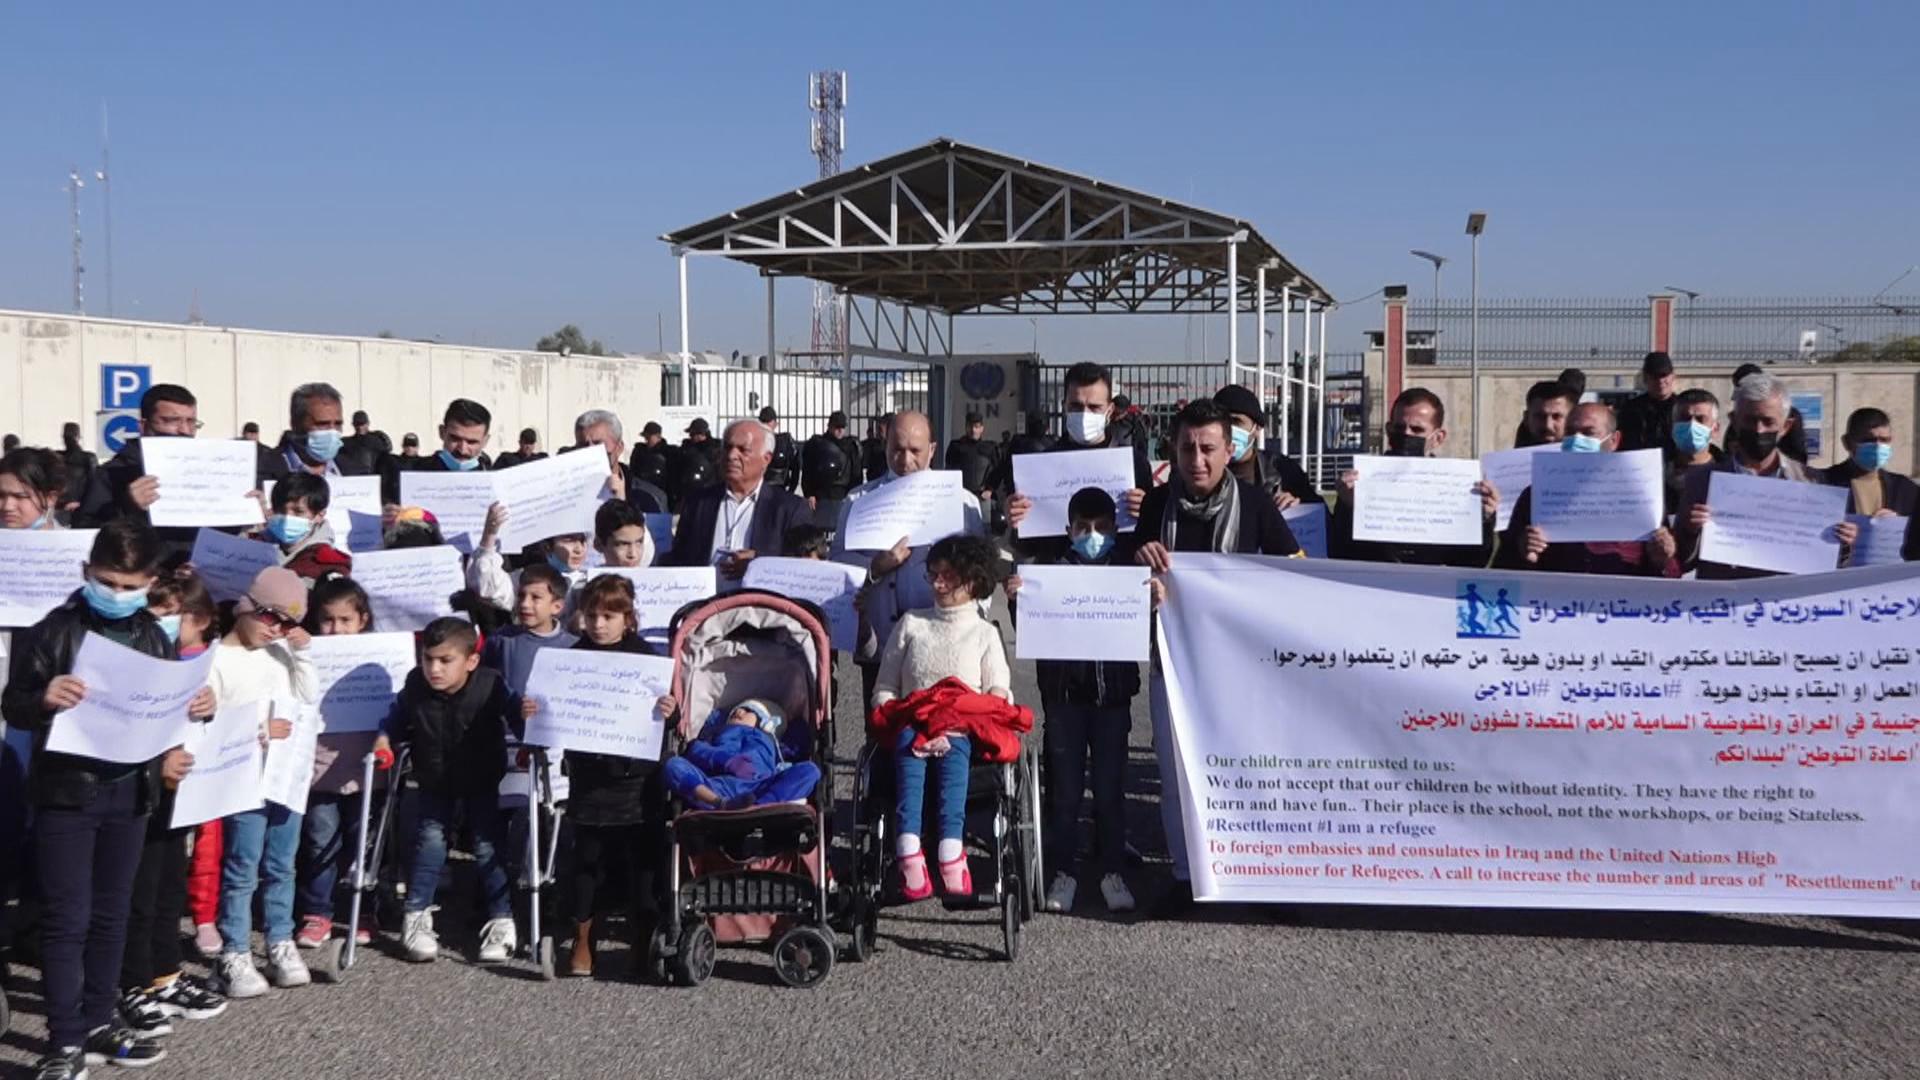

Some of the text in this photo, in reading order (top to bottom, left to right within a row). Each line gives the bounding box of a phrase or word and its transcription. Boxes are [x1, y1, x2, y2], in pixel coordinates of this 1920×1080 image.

[112, 371, 141, 407] P
[1076, 611, 1138, 620] RESETTLEMENT
[1744, 598, 1766, 627] في
[1343, 648, 1395, 669] يتعلموا
[1421, 648, 1461, 669] حقهم
[1468, 651, 1488, 669] من
[1545, 653, 1584, 672] بدون
[1611, 650, 1653, 671] القيد
[1659, 650, 1718, 675] مكتومي
[1794, 654, 1841, 673] يصبح
[1748, 684, 1789, 703] بدون
[1524, 712, 1580, 729] المتحدة
[1632, 711, 1696, 735] السامية
[1787, 714, 1839, 735] العراق
[1845, 712, 1866, 739] في
[1206, 754, 1455, 772] Our children are entrusted to us:
[1206, 775, 1815, 803] We do not accept that our children be without identity. They have the right to
[1207, 797, 1244, 810] learn
[1250, 798, 1277, 811] and
[1282, 798, 1317, 811] have
[1361, 799, 1403, 813] Their
[1409, 800, 1448, 817] place
[1453, 800, 1465, 815] is
[1470, 801, 1495, 816] the
[1498, 803, 1553, 818] school,
[1558, 806, 1584, 818] not
[1588, 805, 1613, 819] the
[1618, 806, 1711, 824] workshops,
[1716, 810, 1734, 821] or
[1739, 807, 1785, 824] being
[1788, 807, 1864, 822] Stateless.
[1207, 818, 1436, 839] #Resettlement #I am a refugee
[1210, 840, 1777, 869] To foreign embassies and consulates in Iraq and the United Nations High
[1212, 861, 1319, 876] Commissioner
[1325, 863, 1347, 877] for
[1352, 864, 1424, 882] Refugees.
[1430, 867, 1441, 879] A
[1446, 866, 1472, 880] call
[1478, 868, 1493, 881] to
[1498, 866, 1561, 882] increase
[1567, 868, 1591, 883] the
[1597, 871, 1659, 885] number
[1664, 871, 1696, 885] and
[1700, 875, 1744, 886] areas
[1748, 872, 1766, 887] of
[1775, 873, 1905, 891] "Resettlement"
